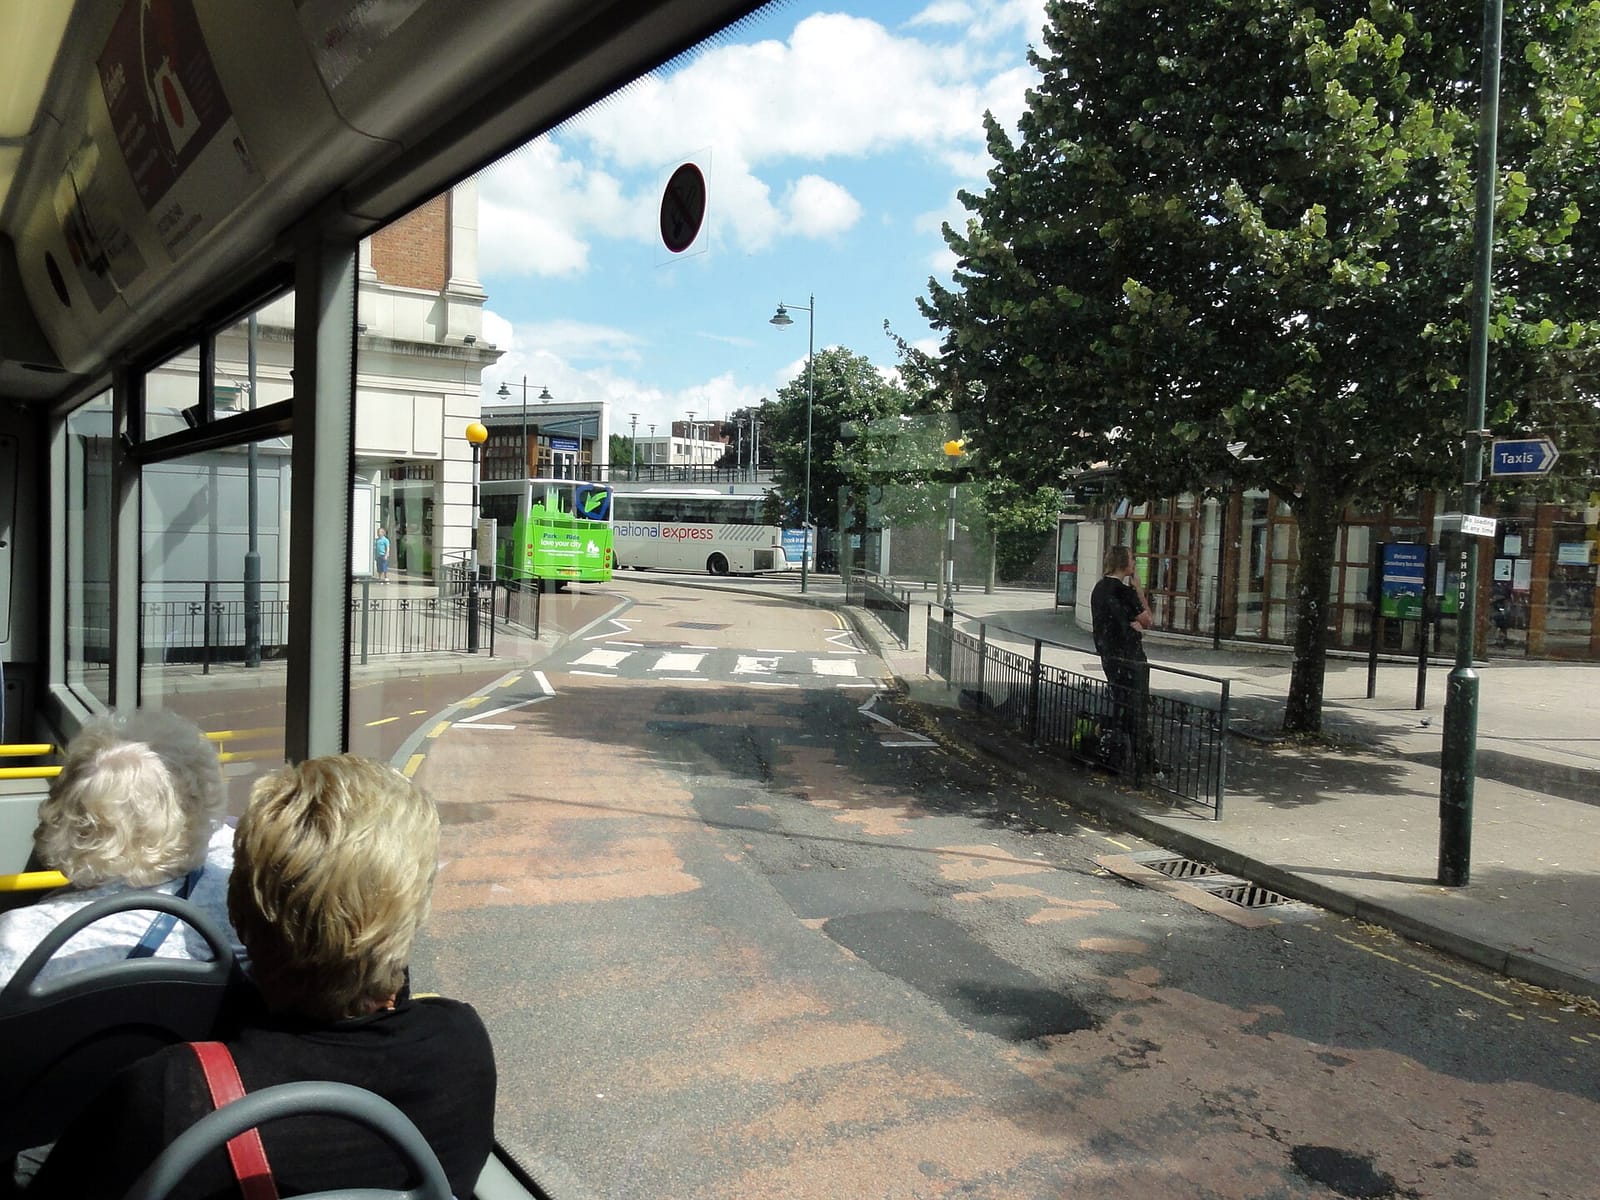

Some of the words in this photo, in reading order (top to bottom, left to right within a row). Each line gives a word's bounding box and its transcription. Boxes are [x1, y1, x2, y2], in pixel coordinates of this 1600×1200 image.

[1500, 452, 1534, 464] Taxis
[613, 522, 660, 538] national
[662, 527, 714, 543] express
